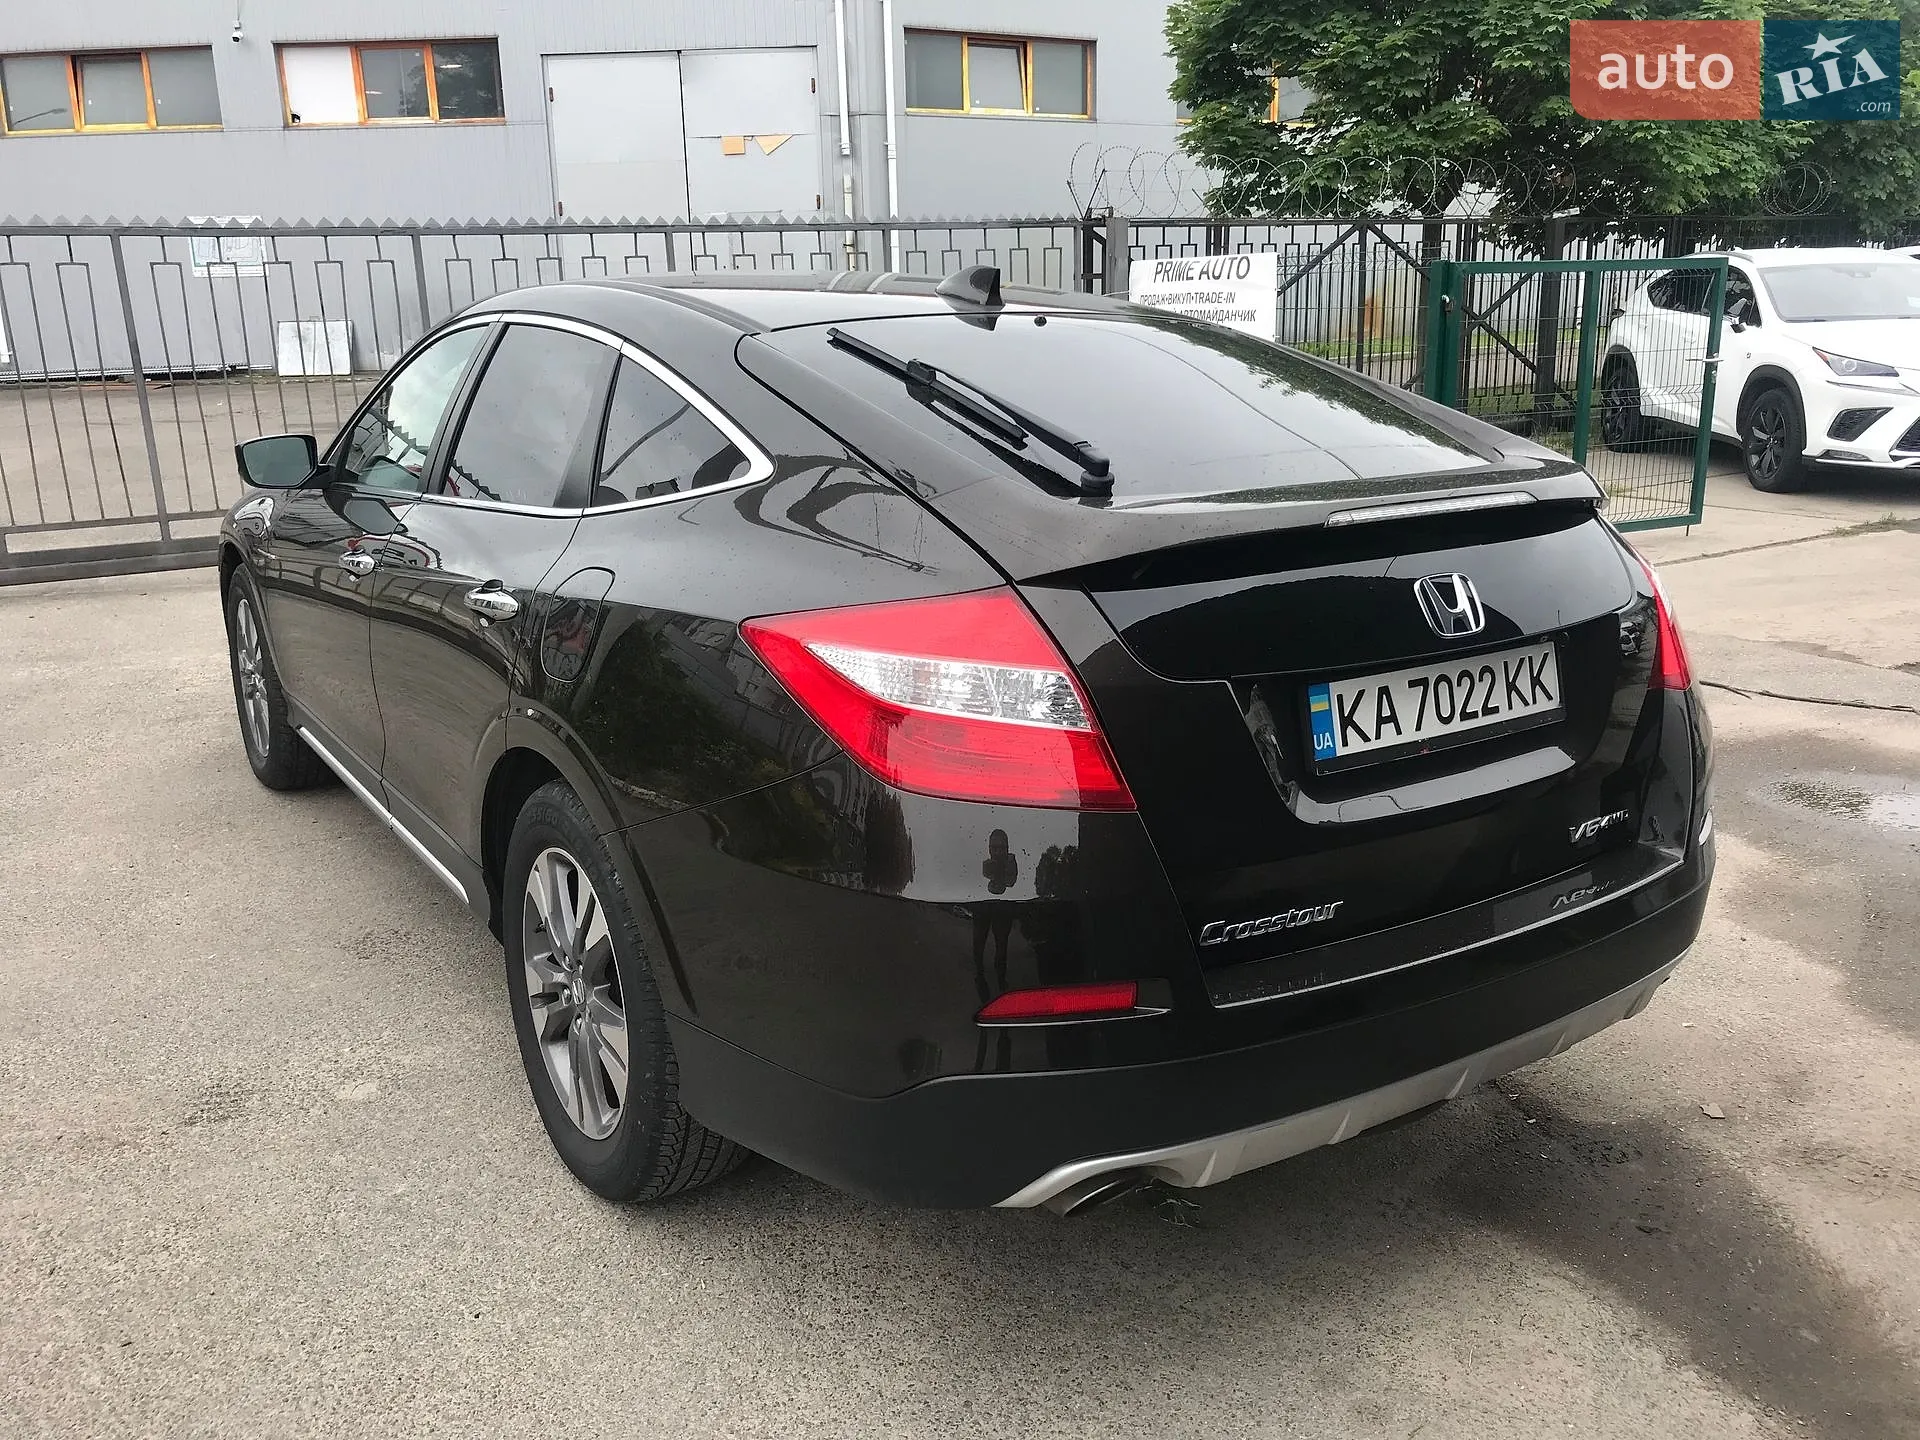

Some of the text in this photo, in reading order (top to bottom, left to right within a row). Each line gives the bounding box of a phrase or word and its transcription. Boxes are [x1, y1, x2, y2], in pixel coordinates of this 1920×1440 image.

[1154, 255, 1251, 283] PRIME AUTO
[1336, 651, 1554, 748] KA 7022 KK
[1313, 732, 1334, 750] UA
[1200, 900, 1344, 947] Crosstour
